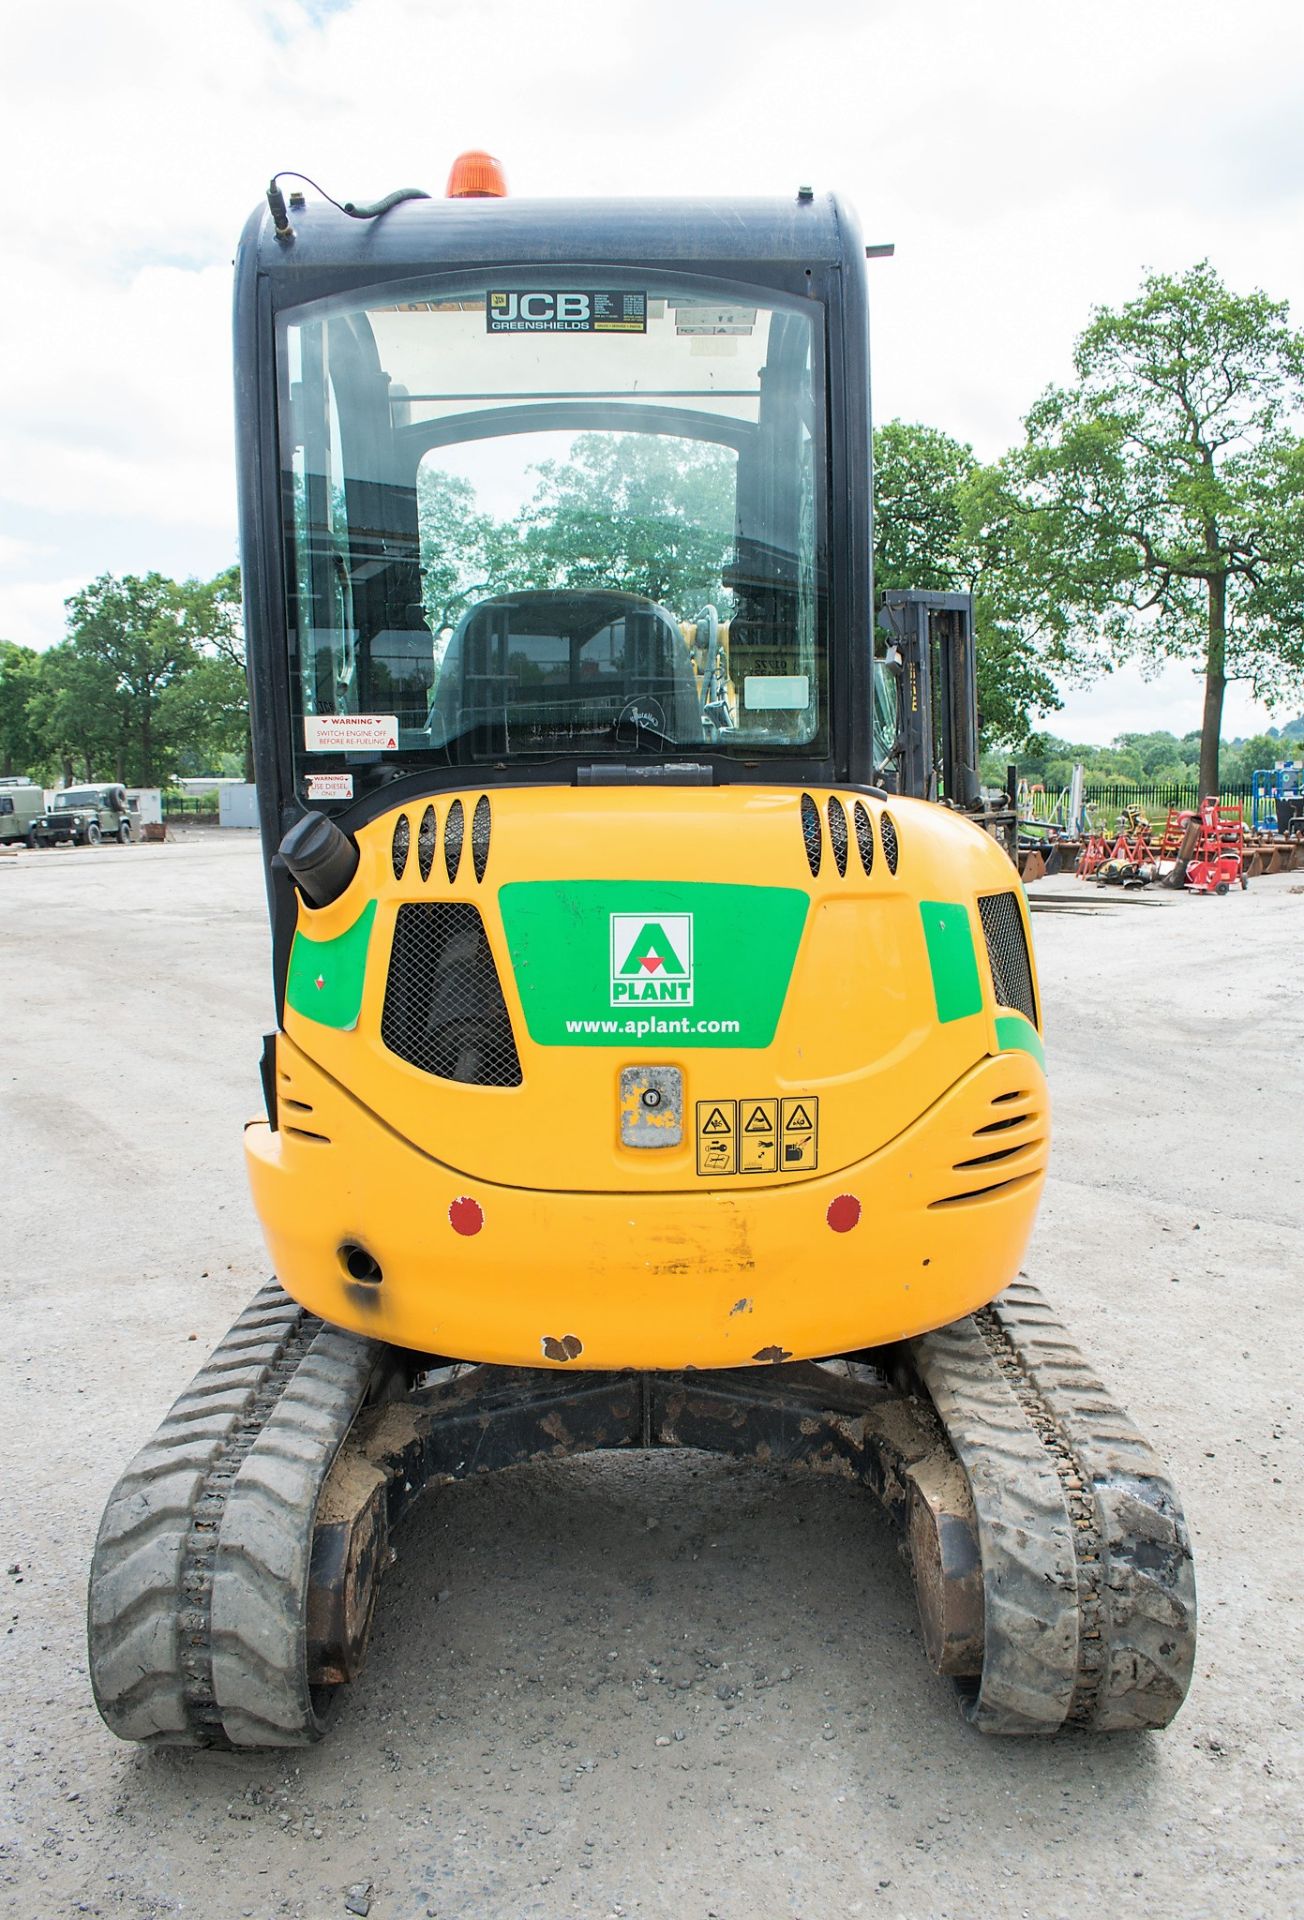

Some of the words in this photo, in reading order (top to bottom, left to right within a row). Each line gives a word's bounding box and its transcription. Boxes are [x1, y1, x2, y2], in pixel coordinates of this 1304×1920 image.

[491, 293, 591, 321] JCB
[491, 321, 590, 330] GREENSHIELDS
[619, 923, 687, 975] A
[613, 982, 691, 1001] PLANT
[565, 1015, 741, 1038] www.aplant.com
